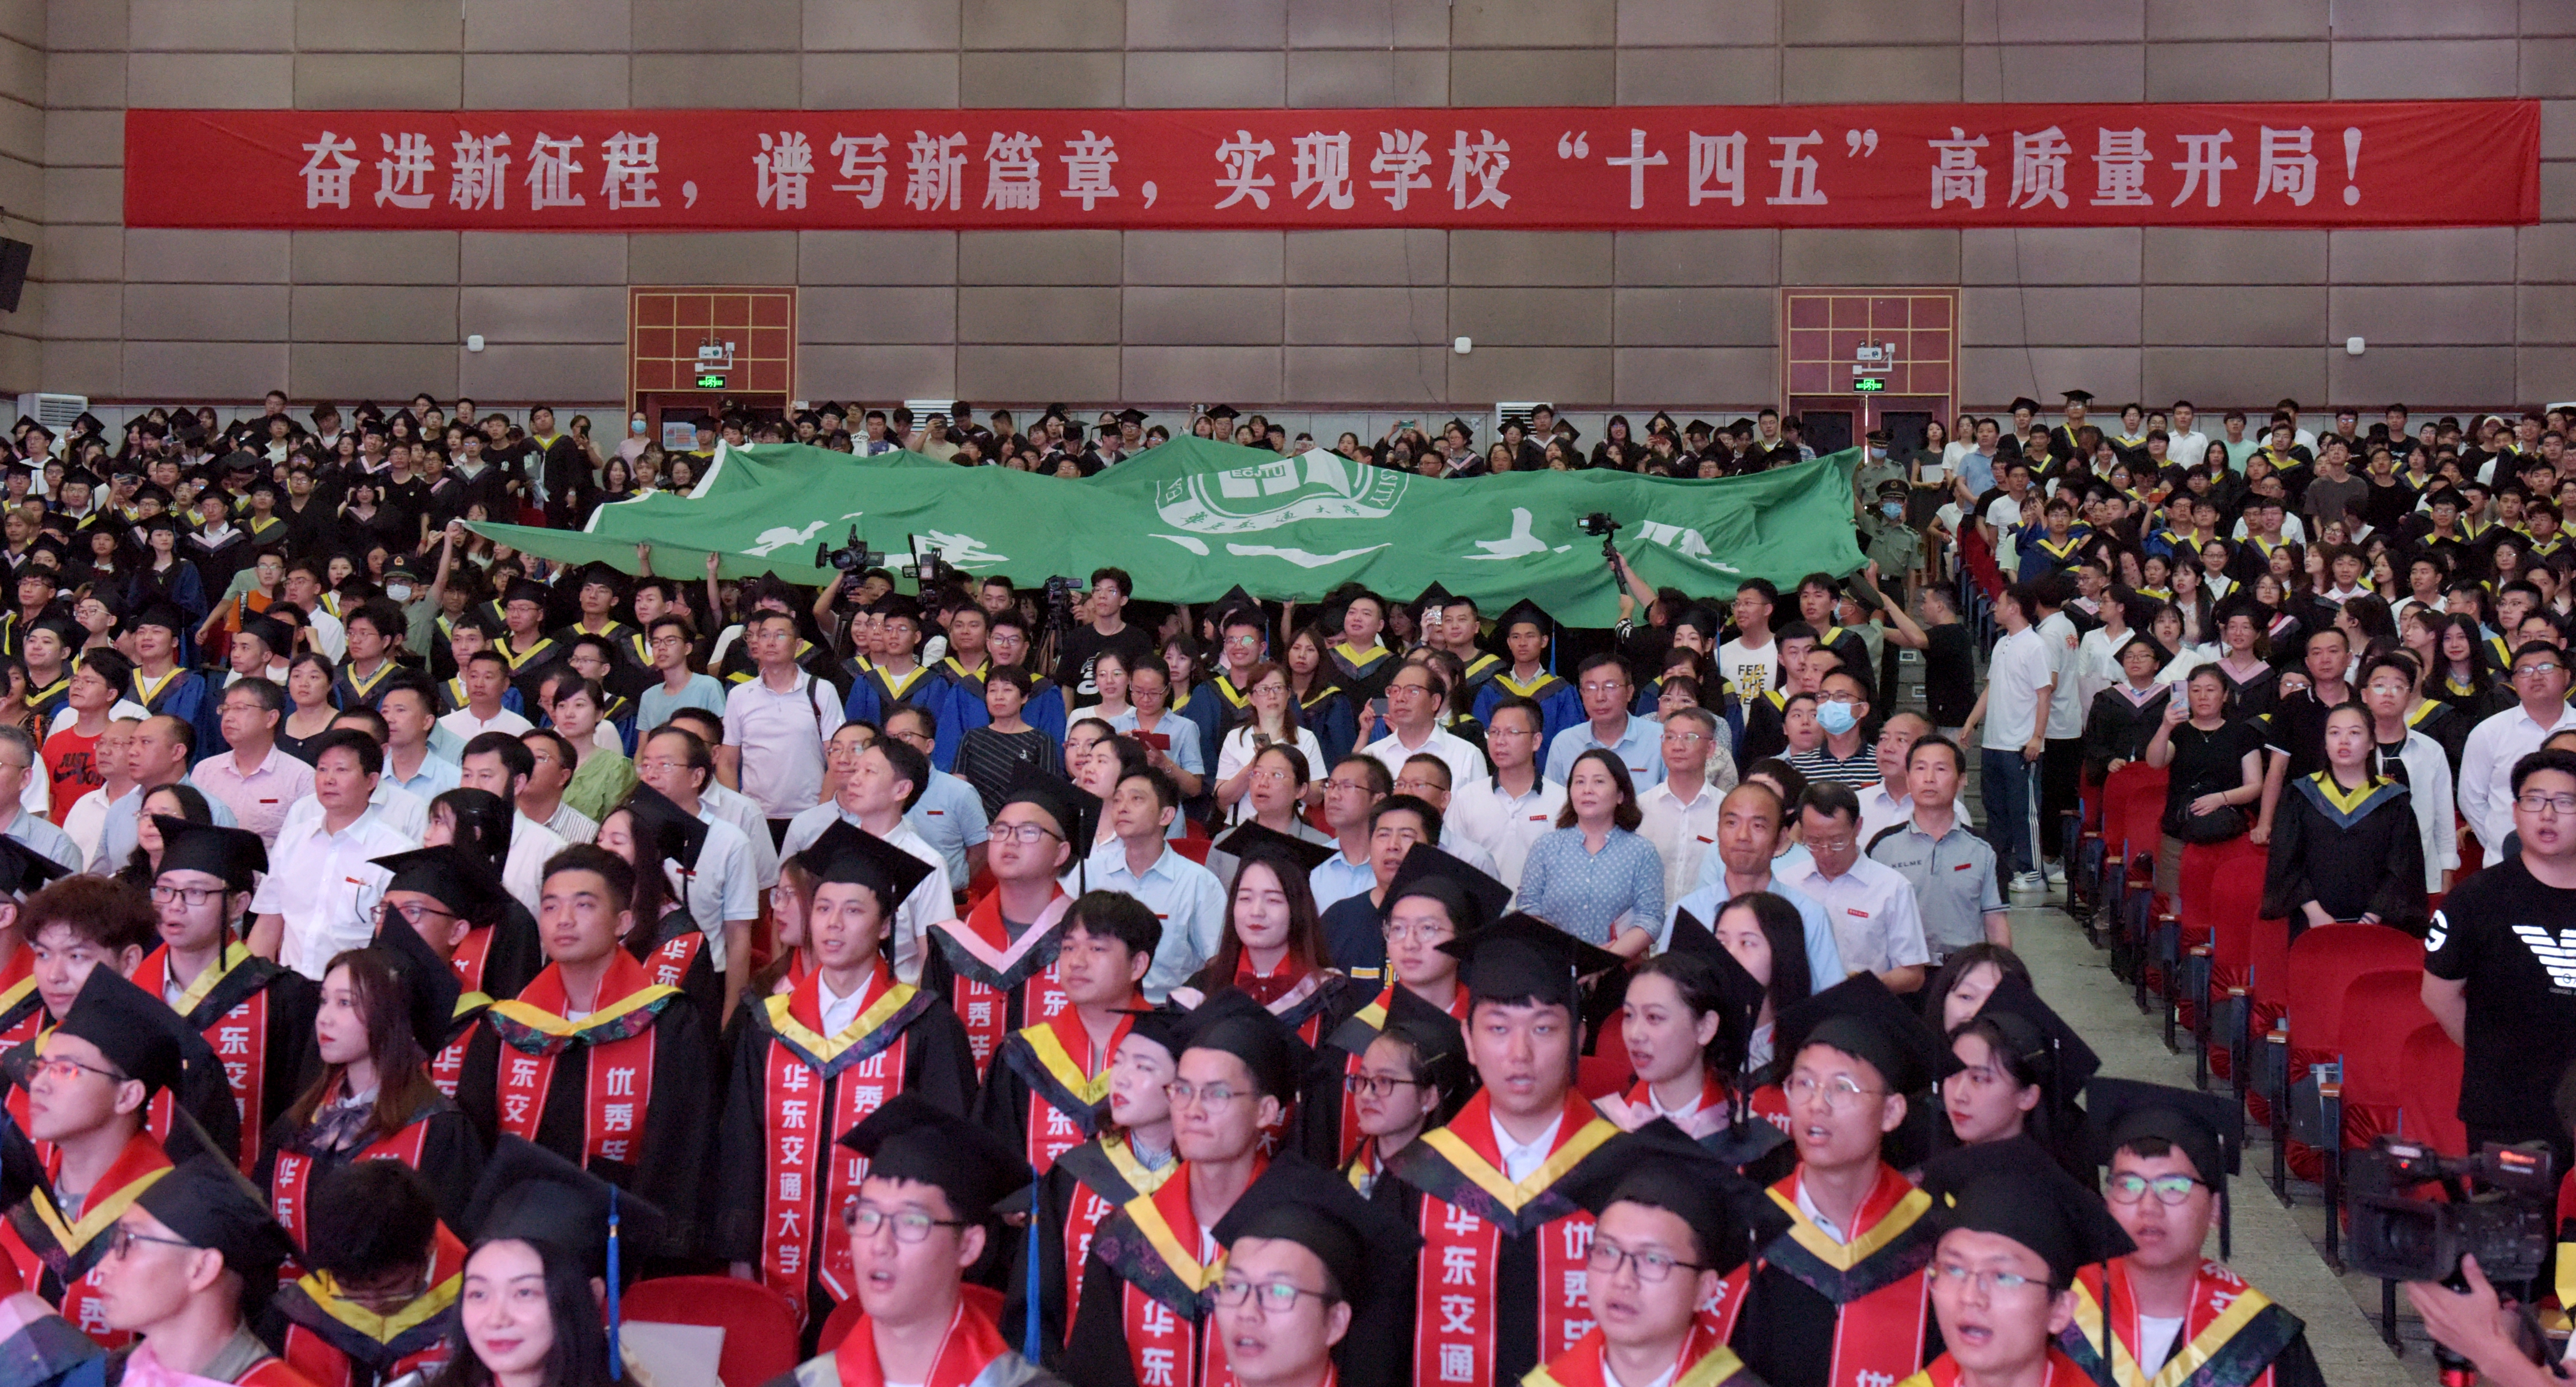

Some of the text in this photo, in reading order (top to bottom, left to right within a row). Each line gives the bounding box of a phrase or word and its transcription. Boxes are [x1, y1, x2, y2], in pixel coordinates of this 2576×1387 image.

[1231, 464, 1284, 478] ECJTU
[1369, 468, 1398, 507] SITY
[1737, 663, 1768, 675] FEEL
[1740, 678, 1765, 690] THE
[58, 752, 91, 768] JUST
[1892, 860, 1922, 868] KELME
[657, 939, 688, 988] 华东
[502, 1058, 540, 1136] 东交
[778, 1063, 811, 1274] 华东交通大学
[1440, 1203, 1480, 1383] 华东交通
[1142, 1299, 1175, 1387] 华东
